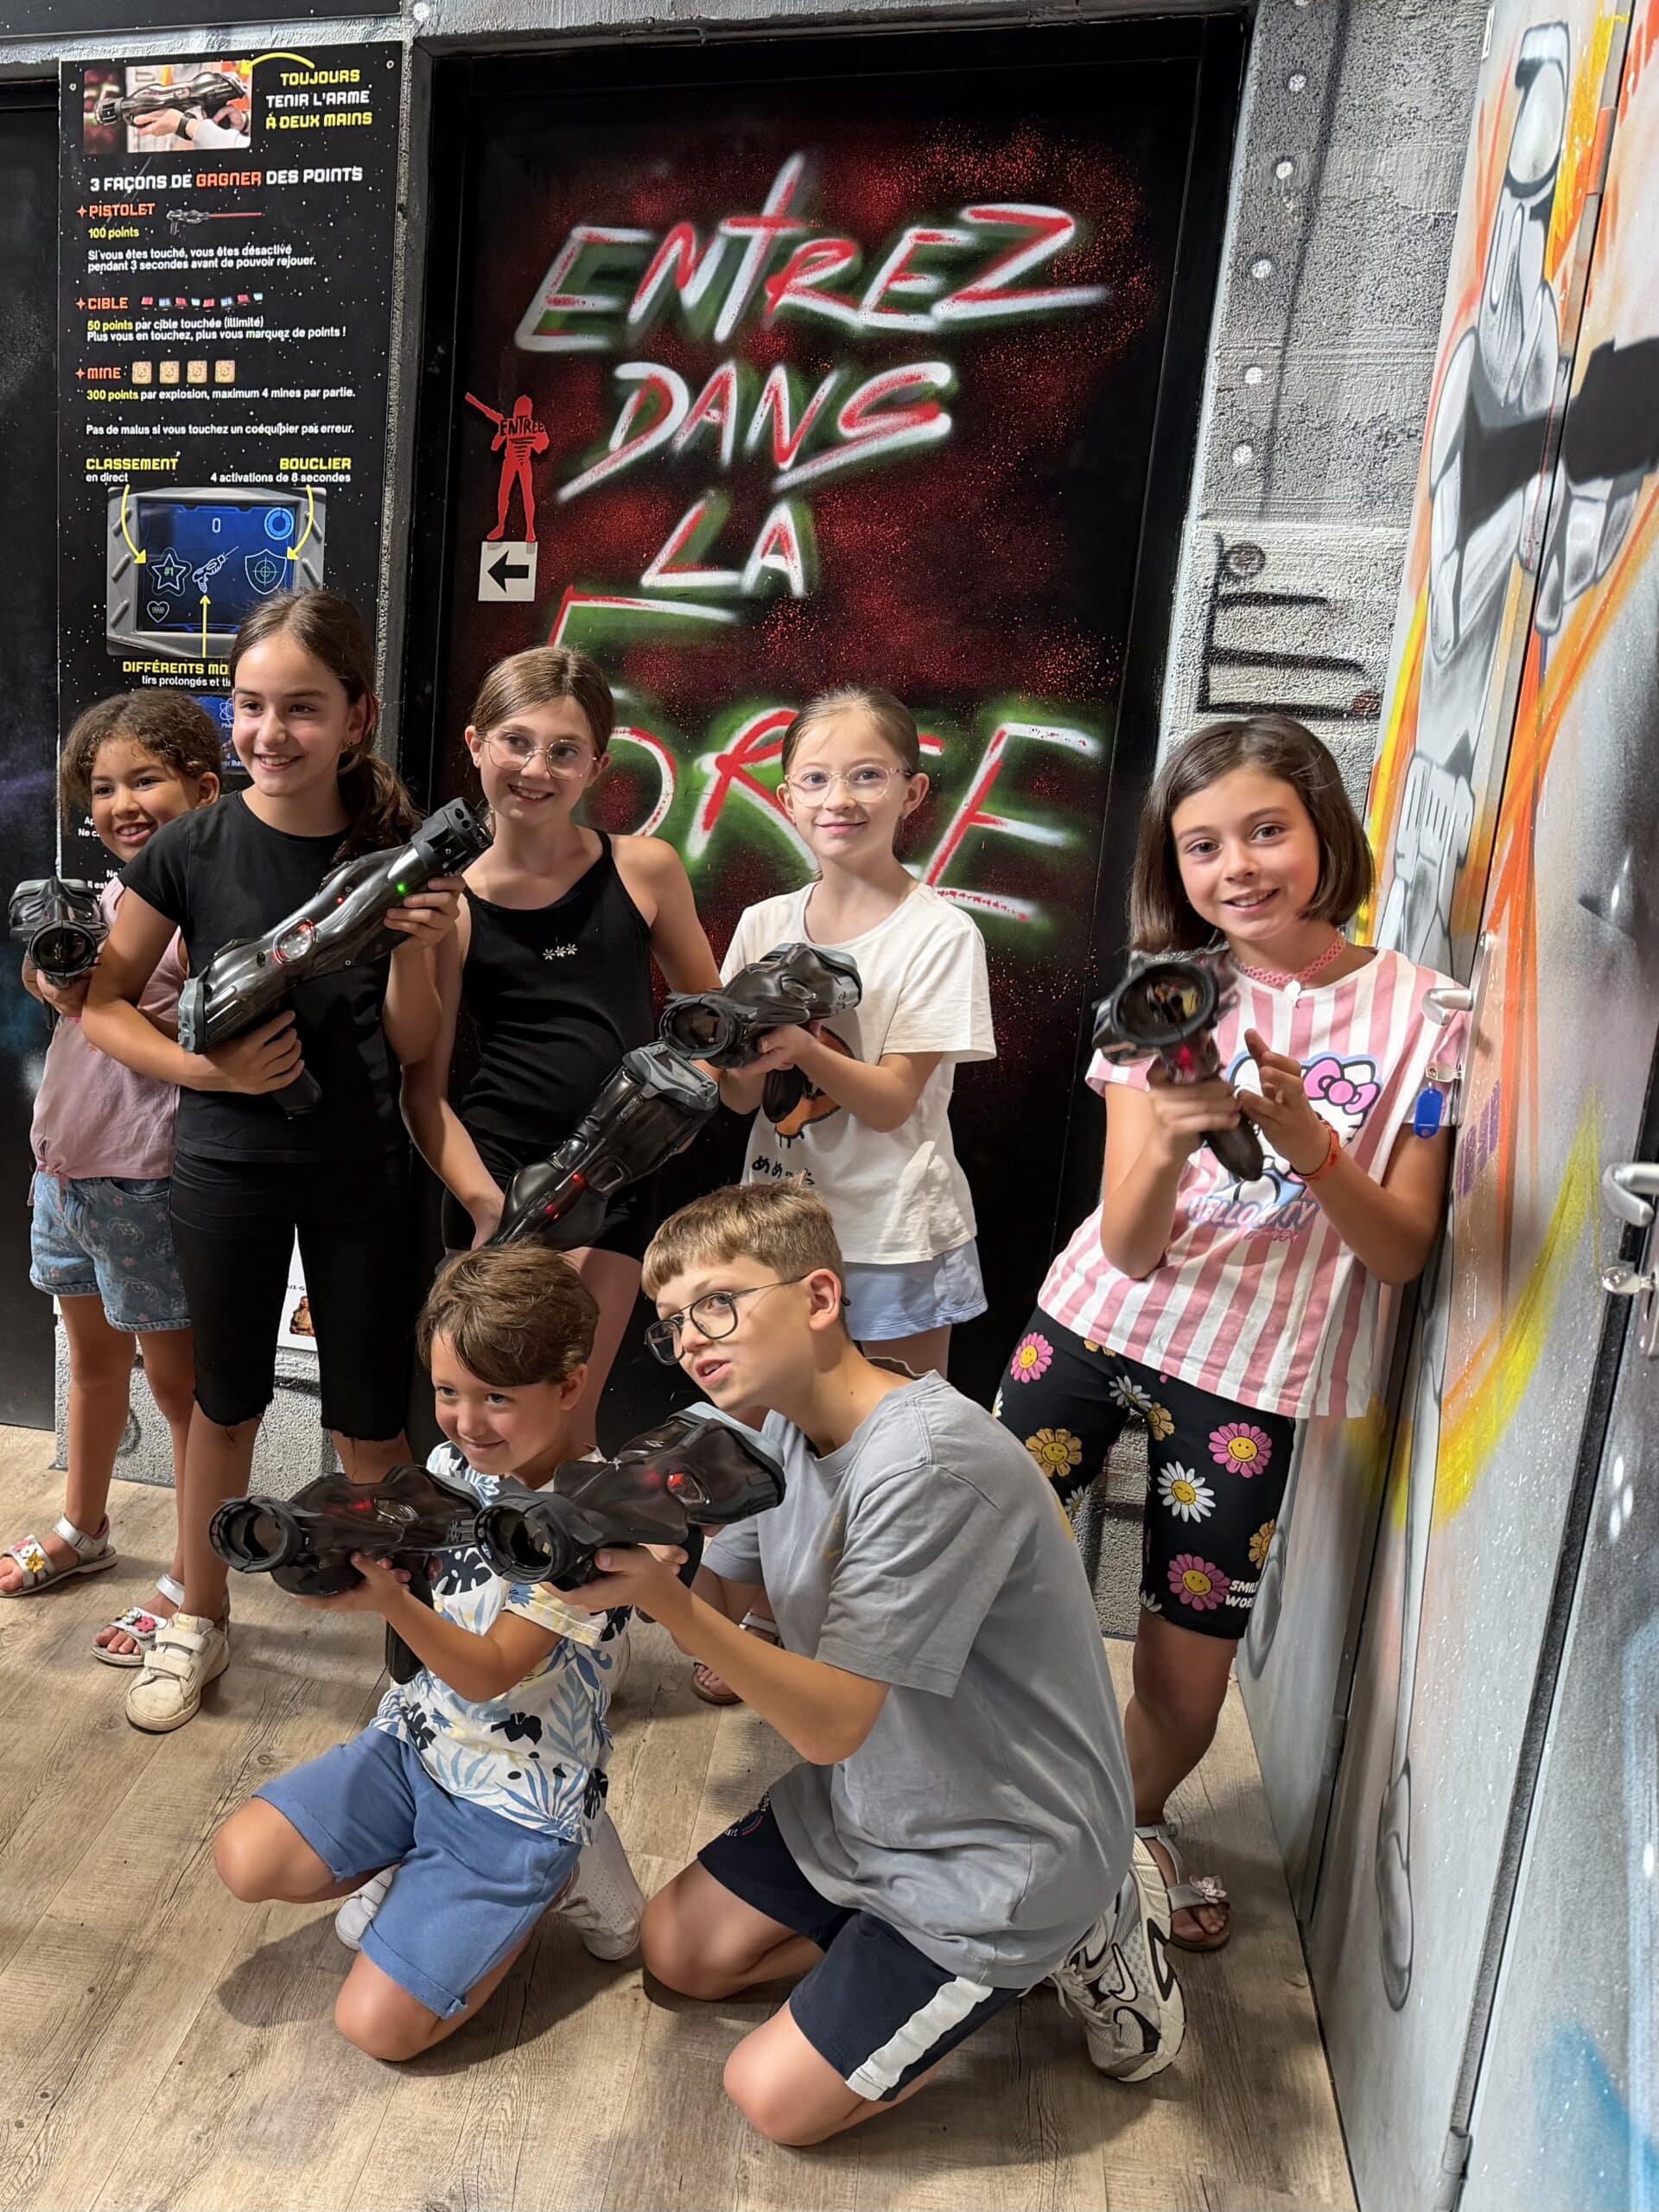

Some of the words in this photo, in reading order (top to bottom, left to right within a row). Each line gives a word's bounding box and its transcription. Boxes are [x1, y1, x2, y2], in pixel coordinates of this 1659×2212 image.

[280, 69, 360, 86] TOUJOURS
[266, 94, 310, 109] TENIR
[313, 90, 370, 105] L'ARME
[265, 111, 276, 130] À
[278, 114, 320, 129] DEUX
[323, 111, 372, 127] MAINS
[90, 178, 100, 192] 3
[104, 174, 167, 194] FAÇONS
[171, 174, 192, 188] DE
[196, 171, 262, 188] GAGNER
[266, 168, 299, 184] DES
[302, 166, 363, 183] POINTS
[88, 202, 156, 219] PISTOLET
[88, 227, 106, 239] 100
[108, 226, 139, 240] points
[88, 249, 97, 260] Si
[99, 251, 124, 260] vous
[125, 248, 148, 259] êtes
[150, 246, 188, 259] touché,
[190, 248, 214, 257] vous
[217, 245, 239, 257] êtes
[241, 243, 292, 257] désactivé
[514, 152, 1109, 351] ENTREZ
[87, 260, 129, 274] pendant
[130, 260, 137, 270] 3
[140, 257, 188, 270] secondes
[191, 258, 219, 269] avant
[221, 257, 234, 269] de
[236, 257, 274, 270] pouvoir
[276, 255, 317, 269] rejouer.
[88, 297, 129, 310] CIBLE
[87, 321, 100, 332] 50
[102, 320, 133, 334] points
[135, 321, 151, 332] par
[153, 318, 178, 331] cible
[181, 317, 222, 329] touchée
[224, 315, 264, 329] (illimité)
[87, 331, 108, 342] Plus
[110, 333, 134, 342] vous
[136, 333, 149, 342] en
[150, 329, 194, 342] touchez,
[195, 330, 218, 342] plus
[219, 331, 243, 340] vous
[245, 330, 289, 343] marquez
[292, 327, 306, 339] de
[308, 327, 340, 340] points
[86, 366, 122, 380] MINE
[86, 389, 105, 400] 300
[108, 389, 139, 402] points
[141, 391, 157, 402] par
[159, 388, 210, 401] explosion,
[213, 388, 260, 400] maximum
[262, 388, 269, 398] 4
[271, 387, 302, 398] mines
[303, 389, 321, 401] par
[322, 386, 356, 400] partie.
[86, 424, 104, 435] Pas
[105, 423, 119, 435] de
[121, 423, 150, 435] malus
[152, 423, 161, 435] si
[162, 424, 186, 434] vous
[188, 423, 228, 435] touchez
[230, 425, 243, 434] un
[245, 423, 299, 436] coéquipier
[301, 425, 319, 436] par
[321, 424, 355, 435] erreur.
[556, 360, 952, 504] DANS
[86, 457, 179, 471] CLASSEMENT
[279, 457, 352, 470] BOUCLIER
[86, 474, 98, 482] en
[99, 472, 129, 482] direct
[210, 472, 217, 482] 4
[219, 472, 274, 482] activations
[276, 472, 289, 482] de
[291, 472, 298, 482] 8
[300, 472, 352, 483] secondes
[640, 494, 810, 598] LA
[122, 658, 205, 675] DIFFÉRENTS
[207, 663, 231, 675] MO
[142, 675, 157, 685] tirs
[158, 675, 207, 688] prolongés
[209, 678, 219, 687] et
[1187, 1196, 1262, 1230] HELLO
[1229, 1580, 1259, 1594] SMIL
